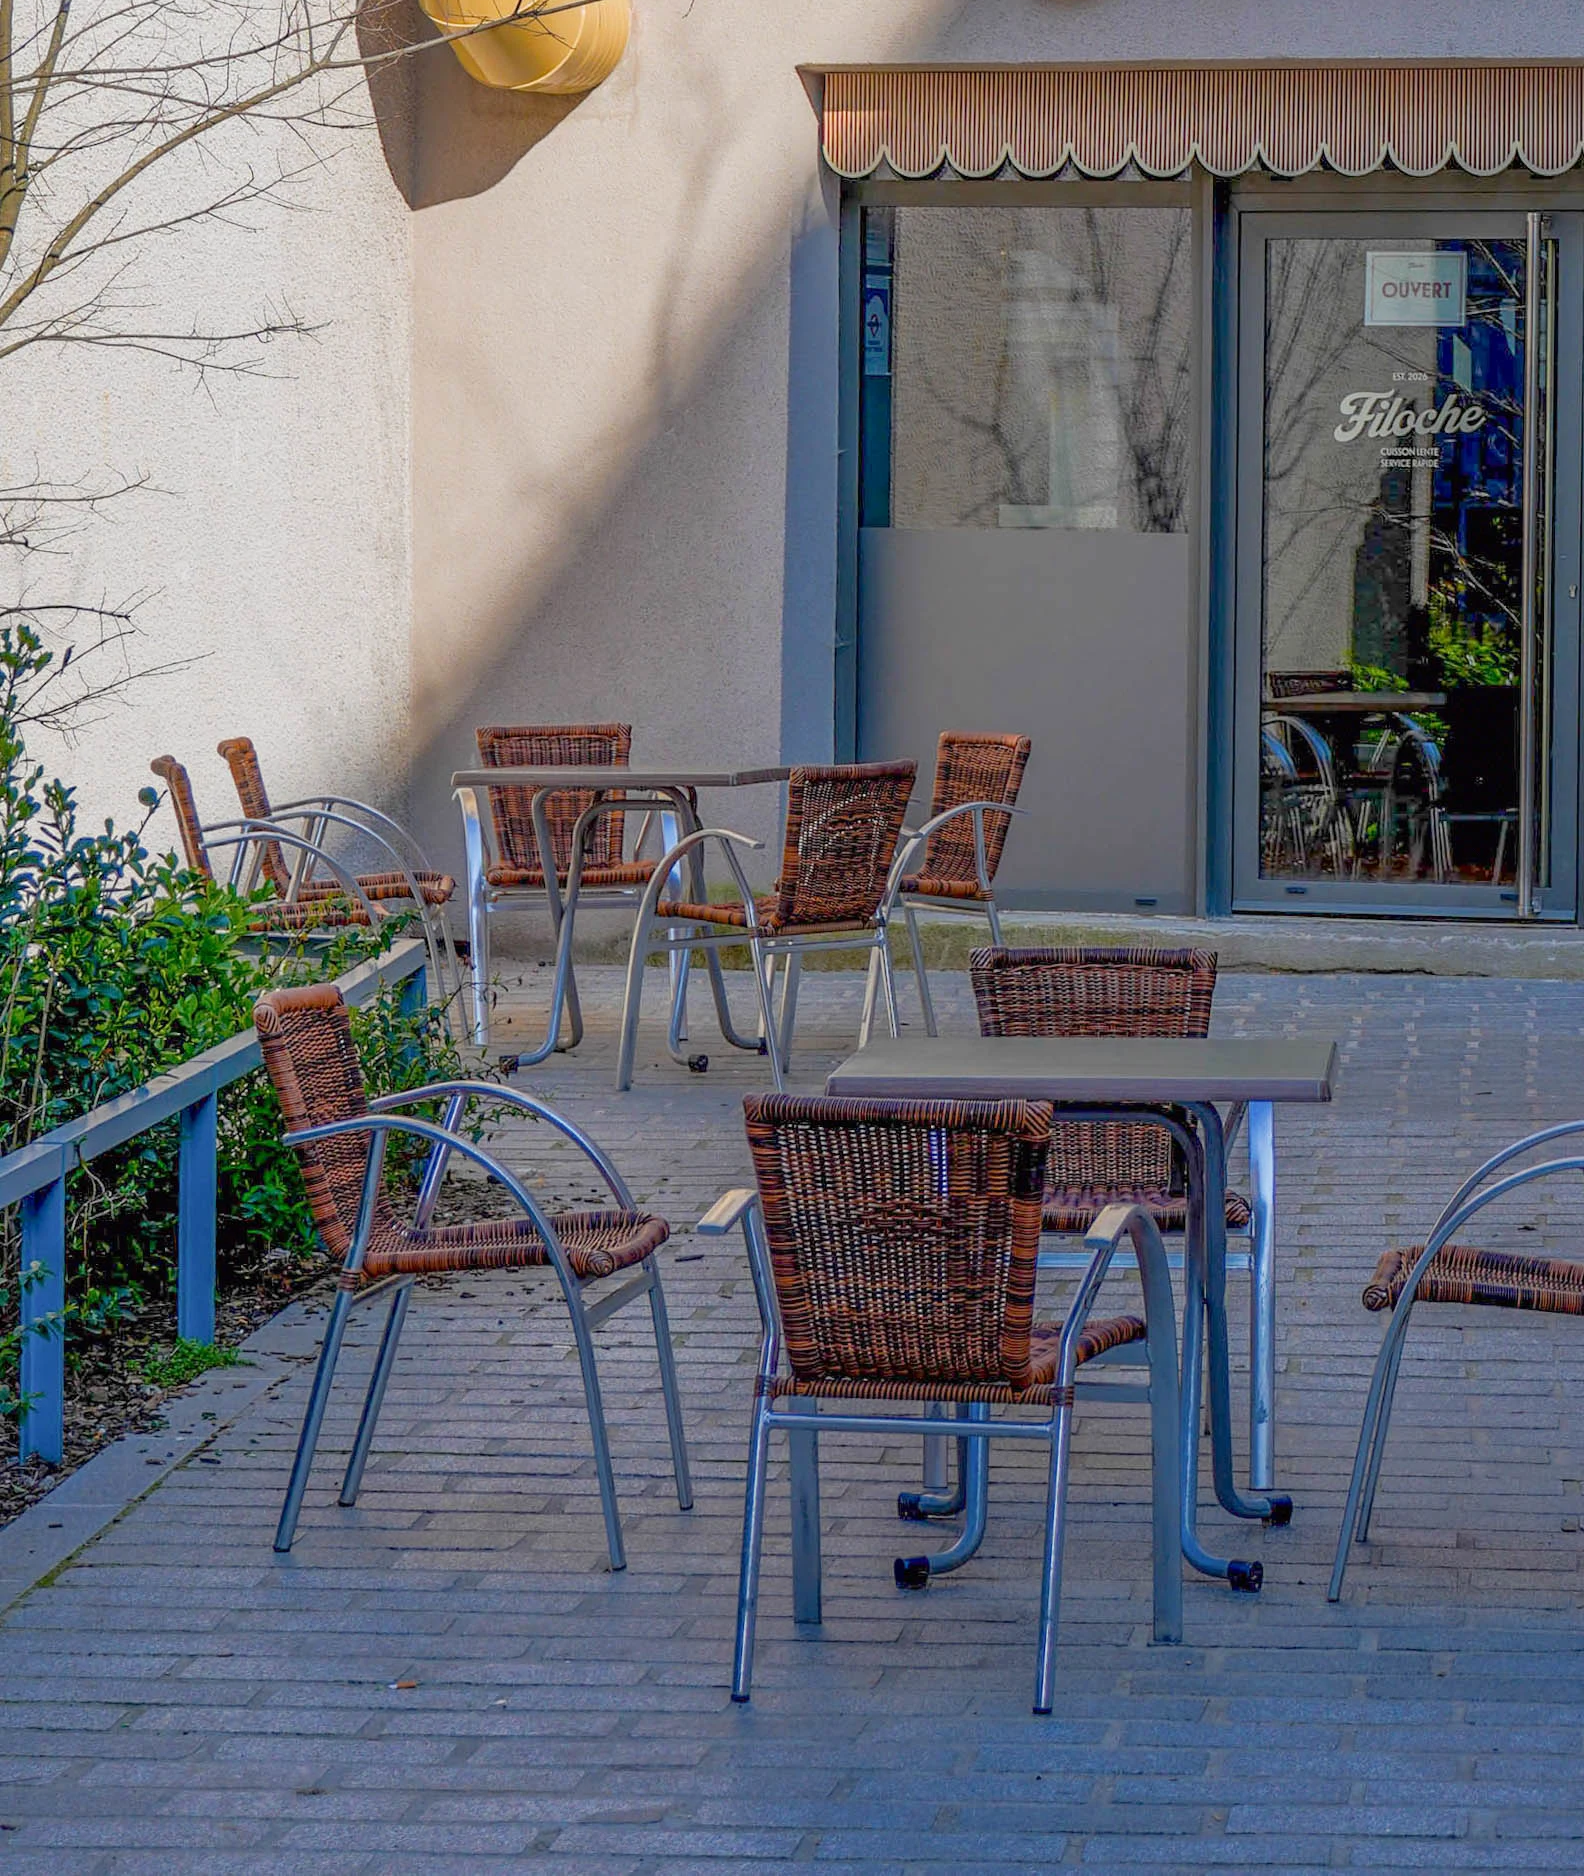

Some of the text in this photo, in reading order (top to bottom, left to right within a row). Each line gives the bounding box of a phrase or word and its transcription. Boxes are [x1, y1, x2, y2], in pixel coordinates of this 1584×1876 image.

[1382, 281, 1453, 299] OUVERT
[1334, 388, 1488, 443] Filoche
[1380, 447, 1440, 457] CUISSON LENTE
[1380, 458, 1440, 468] SERVICE RAPIDE
